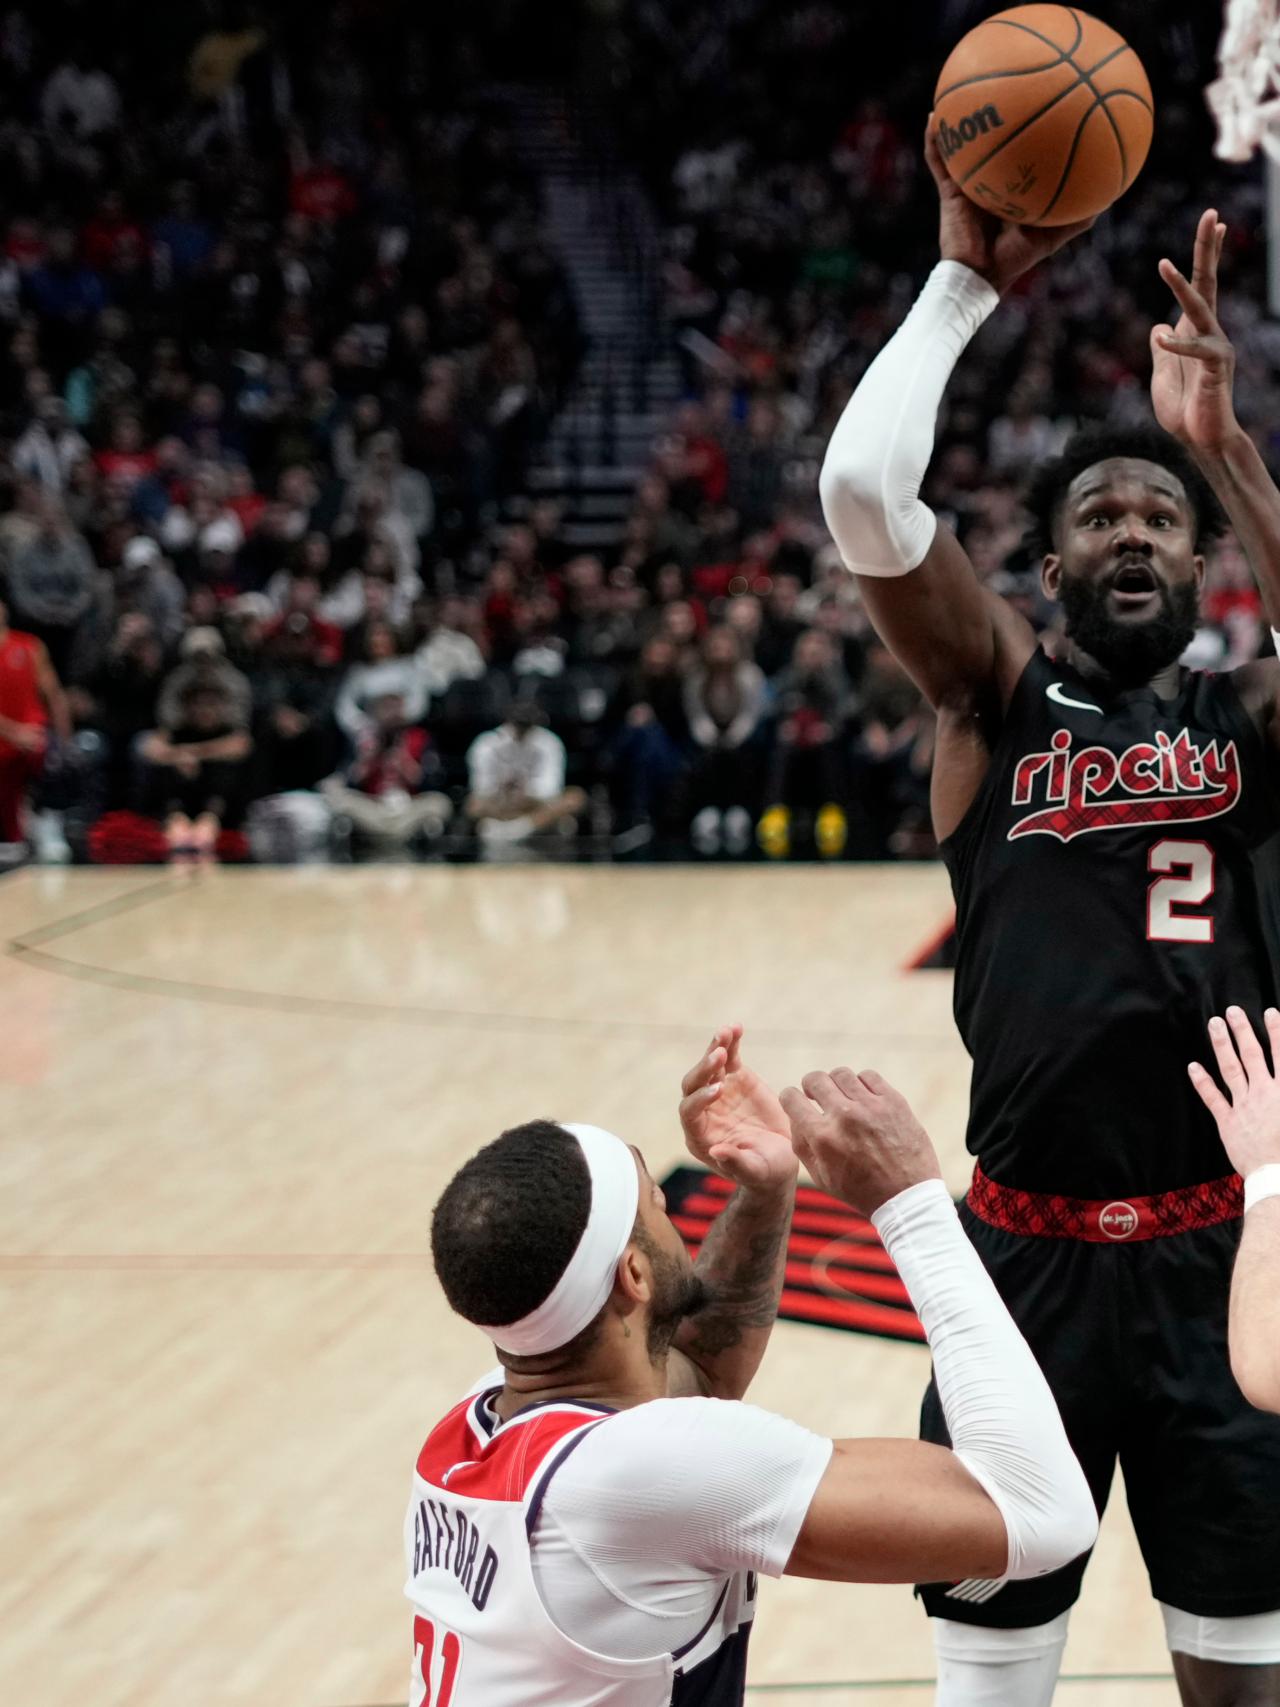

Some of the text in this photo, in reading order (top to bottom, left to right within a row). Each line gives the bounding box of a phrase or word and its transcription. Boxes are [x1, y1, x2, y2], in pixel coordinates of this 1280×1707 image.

[938, 104, 1004, 159] lson
[1007, 727, 1241, 843] ripcity
[1146, 837, 1215, 943] 2
[413, 1498, 499, 1612] GAFFORD
